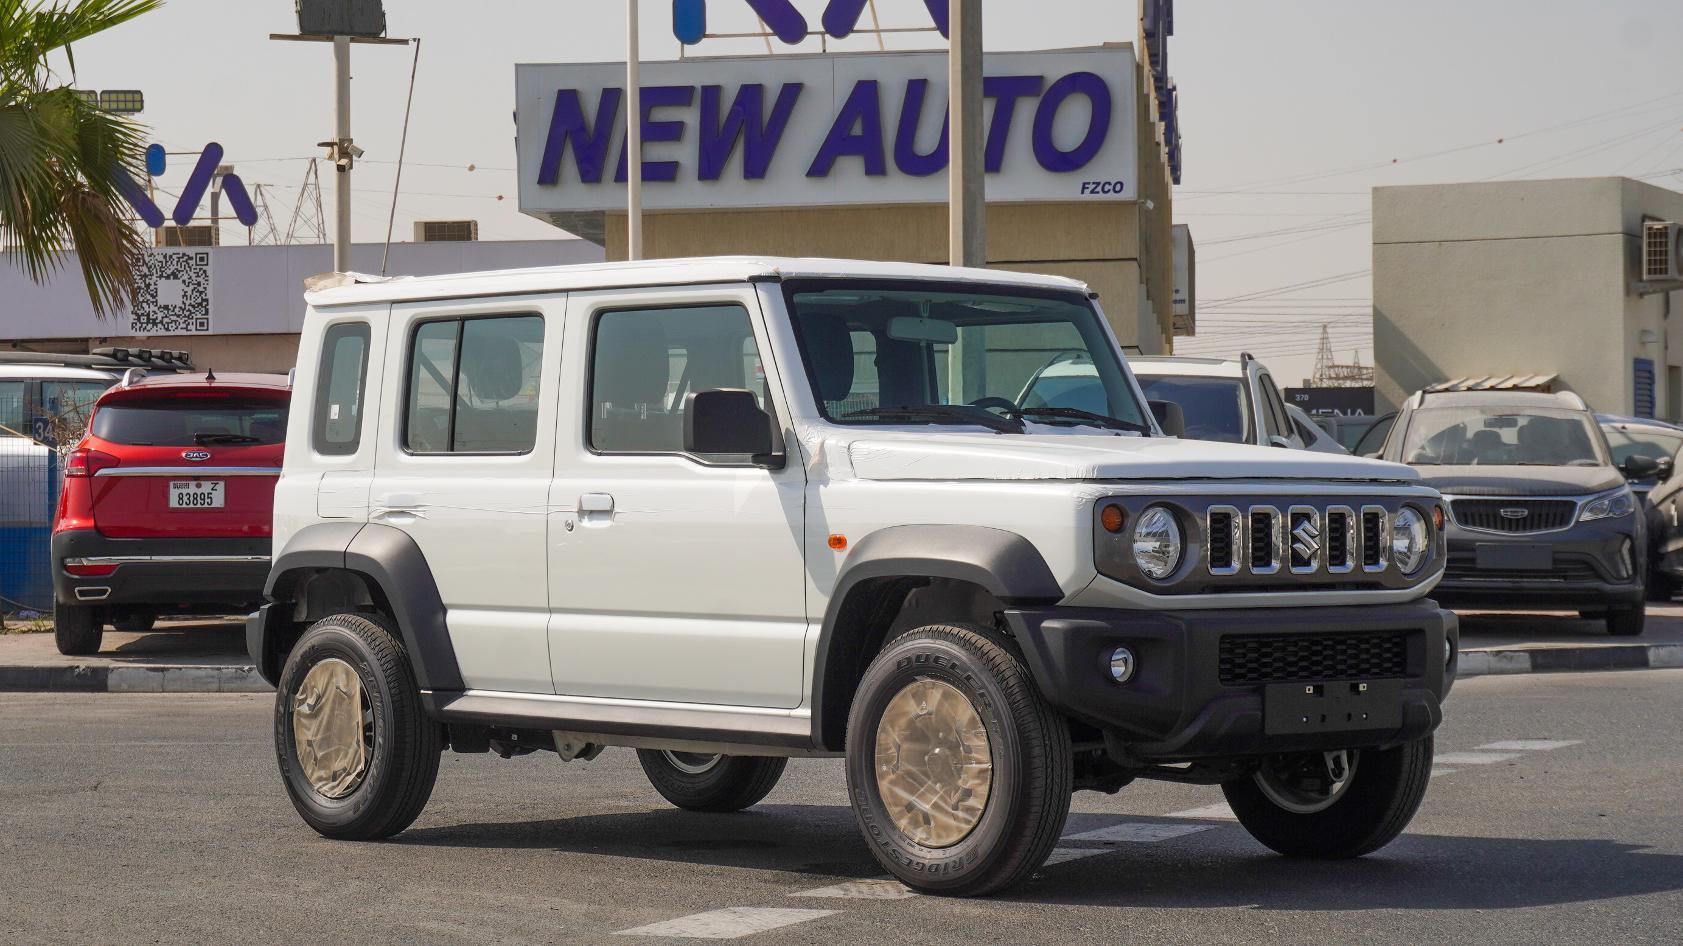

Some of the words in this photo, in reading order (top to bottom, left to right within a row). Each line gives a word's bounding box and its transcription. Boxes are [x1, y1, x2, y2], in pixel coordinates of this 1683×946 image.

[537, 83, 804, 185] NEW
[805, 71, 1112, 178] AUTO
[1080, 180, 1125, 195] FZCO
[177, 492, 213, 506] 83895
